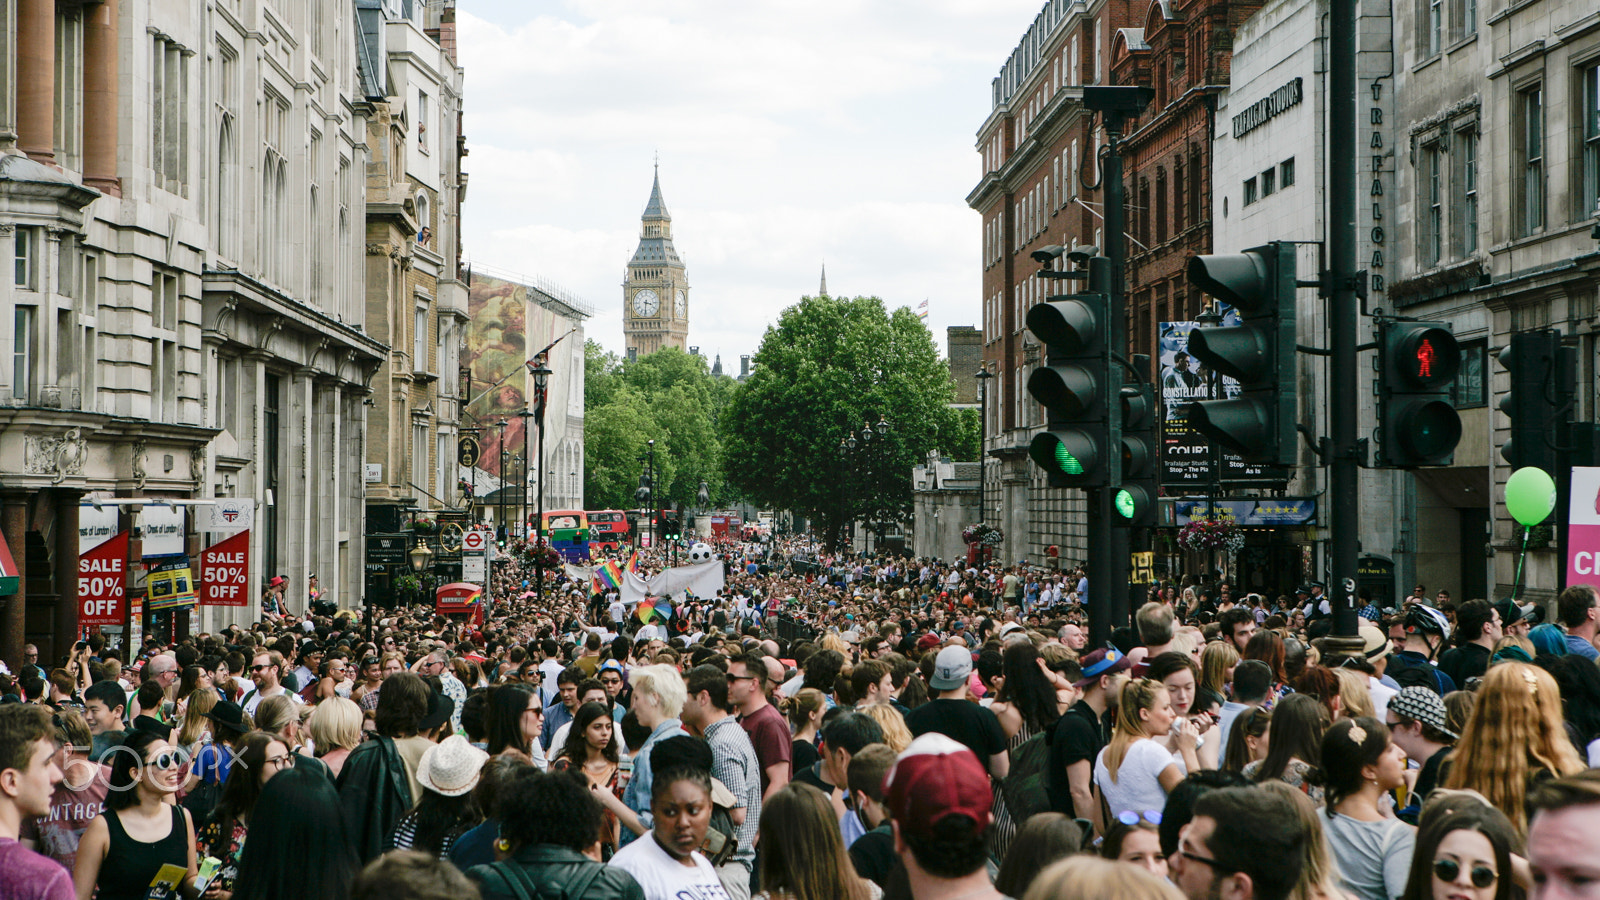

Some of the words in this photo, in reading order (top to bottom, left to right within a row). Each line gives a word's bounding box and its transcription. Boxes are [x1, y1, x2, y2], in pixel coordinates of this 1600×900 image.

[1232, 96, 1270, 138] TRAFALGAR
[1268, 77, 1303, 119] STUDIOS
[1371, 84, 1383, 291] TRAFALGAR
[1163, 387, 1217, 397] CONSTELLATIOS
[95, 525, 110, 536] London
[207, 552, 244, 564] SALE
[80, 559, 122, 572] SALE
[204, 567, 246, 584] 50%
[78, 577, 123, 597] 50%
[209, 585, 239, 598] OFF
[84, 600, 117, 616] OFF
